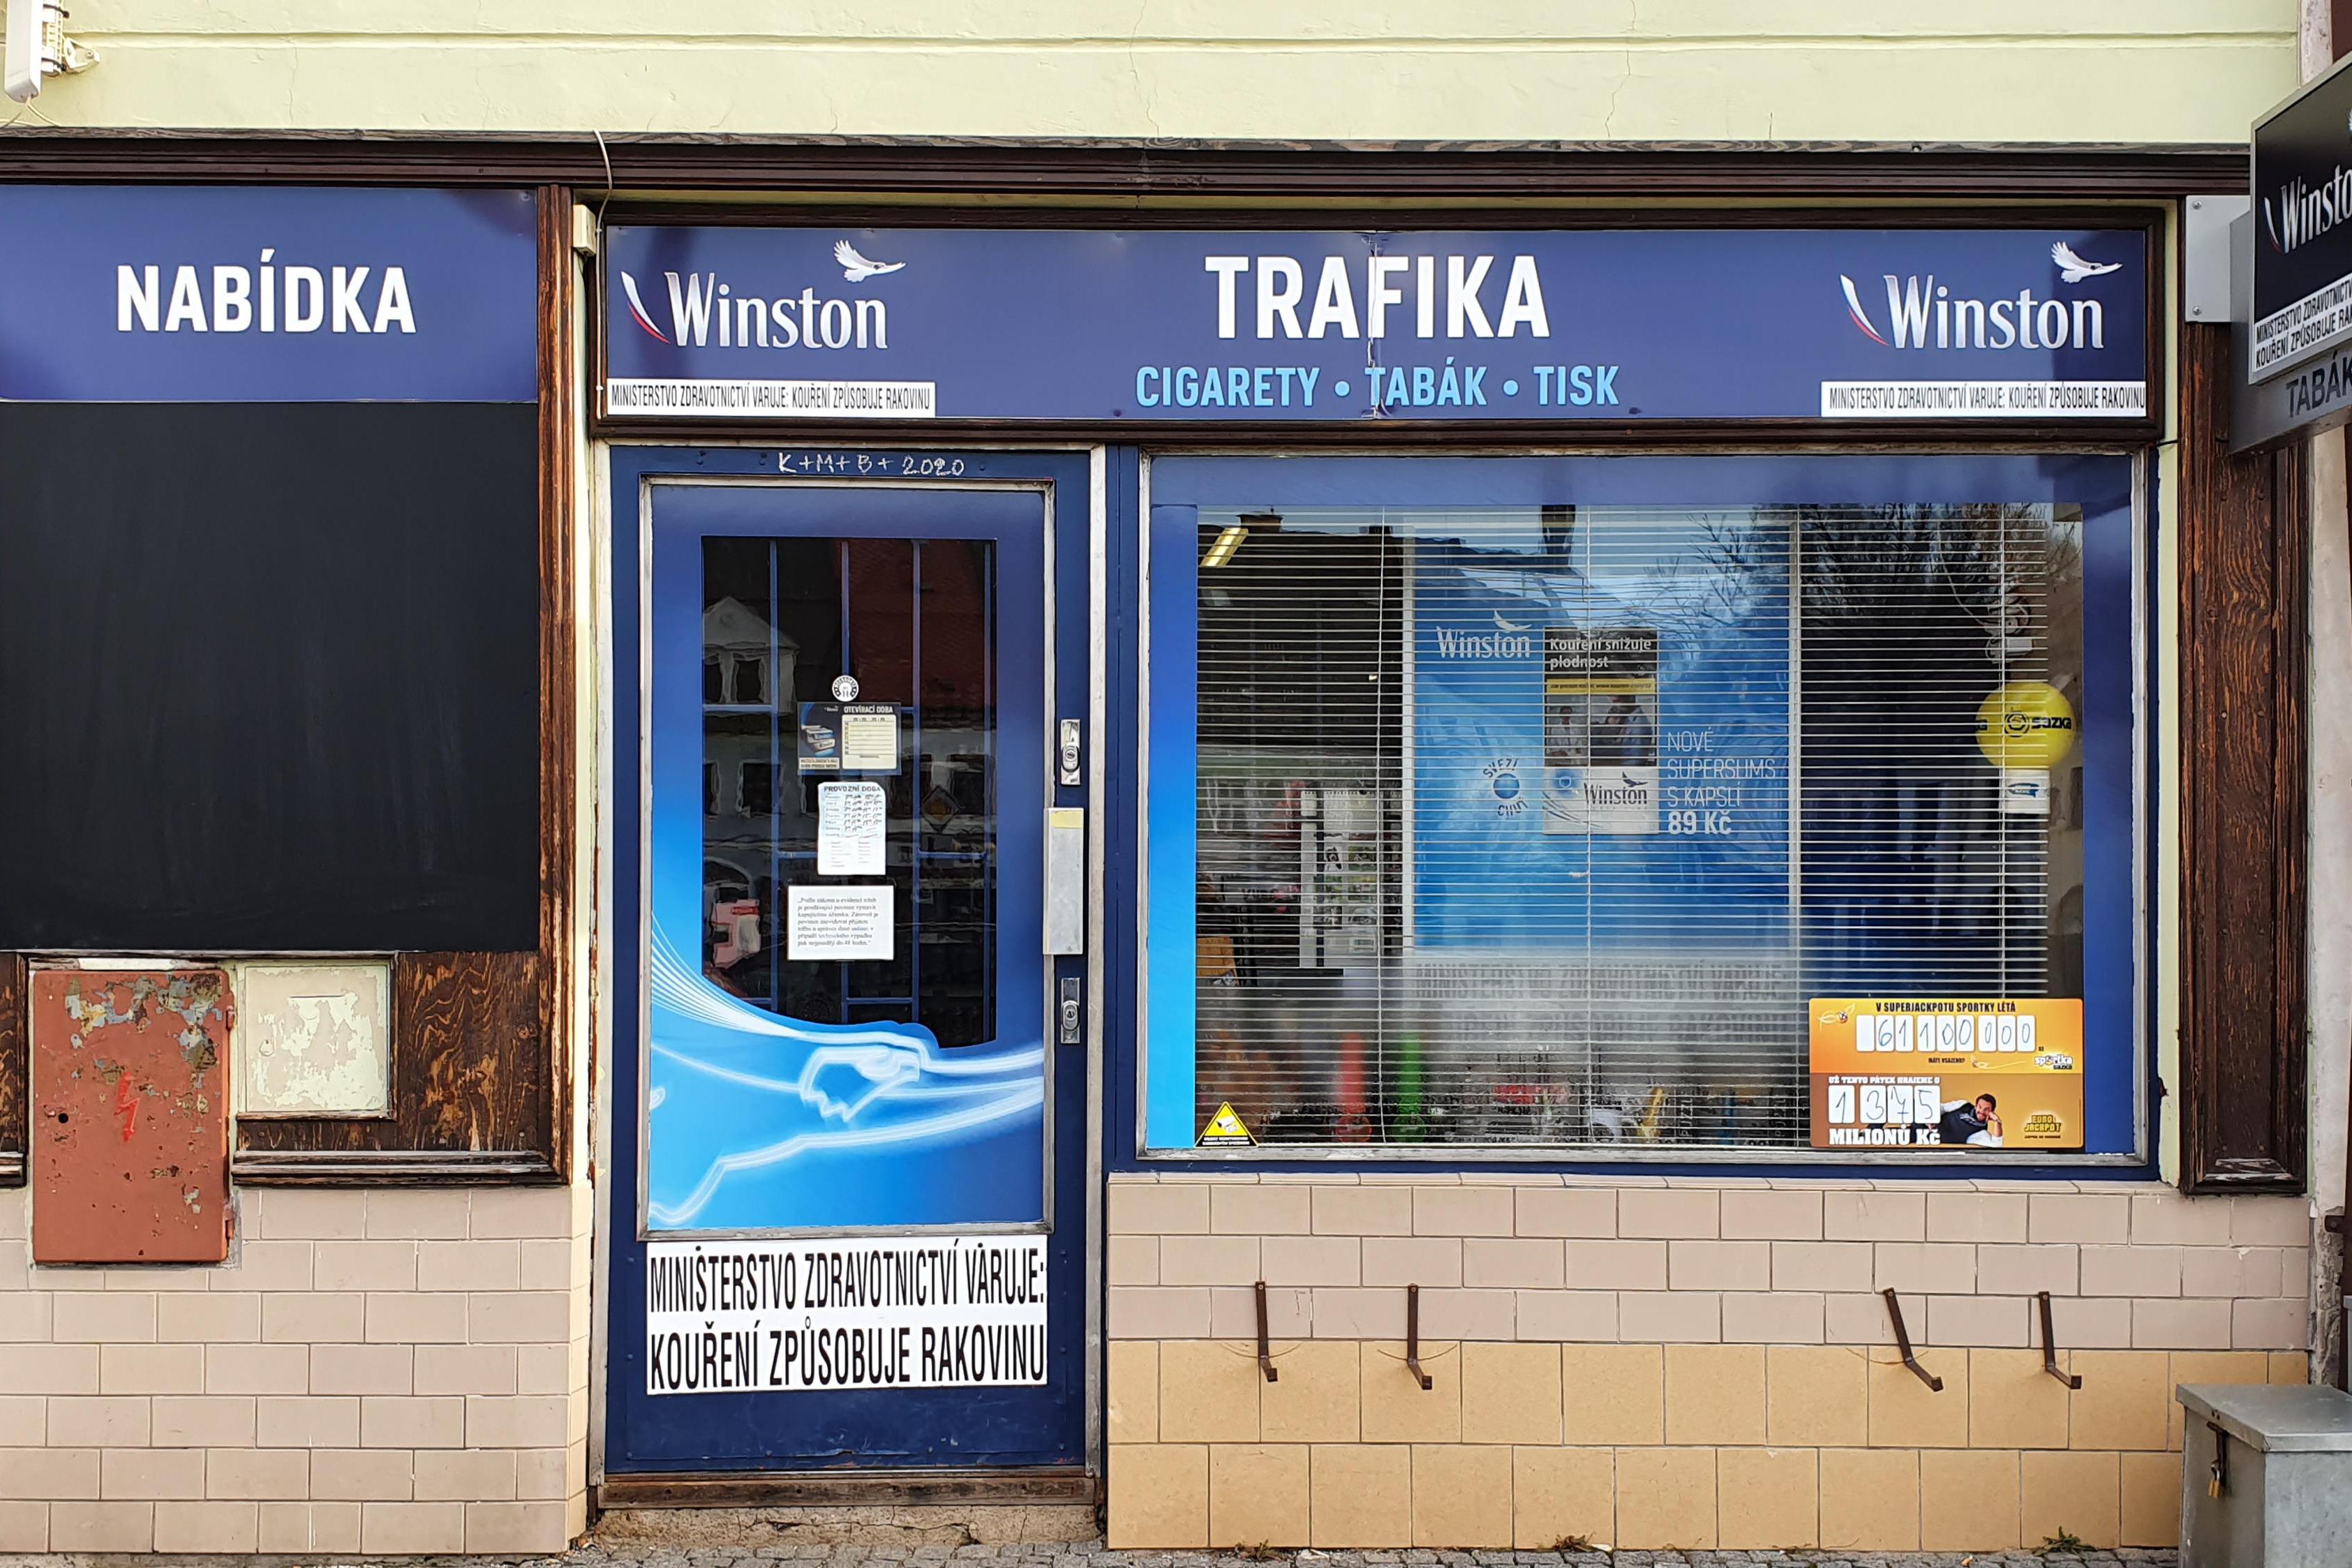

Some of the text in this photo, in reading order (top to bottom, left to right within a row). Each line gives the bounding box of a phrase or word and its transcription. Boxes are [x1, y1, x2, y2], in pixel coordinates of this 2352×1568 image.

[117, 248, 417, 333] NABÍDKA
[1205, 255, 1550, 339] TRAFIKA
[664, 272, 888, 349] Winston
[1883, 274, 2104, 349] Winston
[2256, 304, 2301, 345] MINISTERSTVO
[2256, 331, 2289, 368] KOUŘENÍ
[2291, 311, 2336, 352] ZPŮSOBUJE
[1136, 357, 1620, 406] CIGARETY TABÁK TISK
[611, 382, 930, 410] MINISTERSTVO ZDRAVOTNICTVÍ VARUJE: KOUŘENÍ ZPŮSOBUJE RAKOVINU
[1830, 382, 2145, 410] MINISTERSTVO ZDRAVOTNICTVÍ VARUJE: KOUŘENÍ ZPŮSOBUJE RAKOVINU
[1436, 626, 1530, 659] Winston
[1550, 636, 1651, 653] Kouření snižuje
[1550, 655, 1609, 671] plodnost
[1668, 726, 1713, 752] NOVÉ
[1667, 759, 1776, 779] SUPERSLIMS
[1584, 782, 1647, 804] Winston
[1667, 782, 1741, 807] S KAPSLÍ
[1668, 810, 1732, 835] 89 Kč
[1876, 1001, 2016, 1012] V SUPERJACKPOTU SPORTKY LÉTÁ
[1829, 1124, 1941, 1145] MILIONŮ Kč
[650, 1239, 1044, 1313] MINISTERSTVO ZDRAVOTNICTVÍ VARUJE:
[651, 1316, 1044, 1389] KOUŘENÍ ZPŮSOBUJE RAKOVINU
